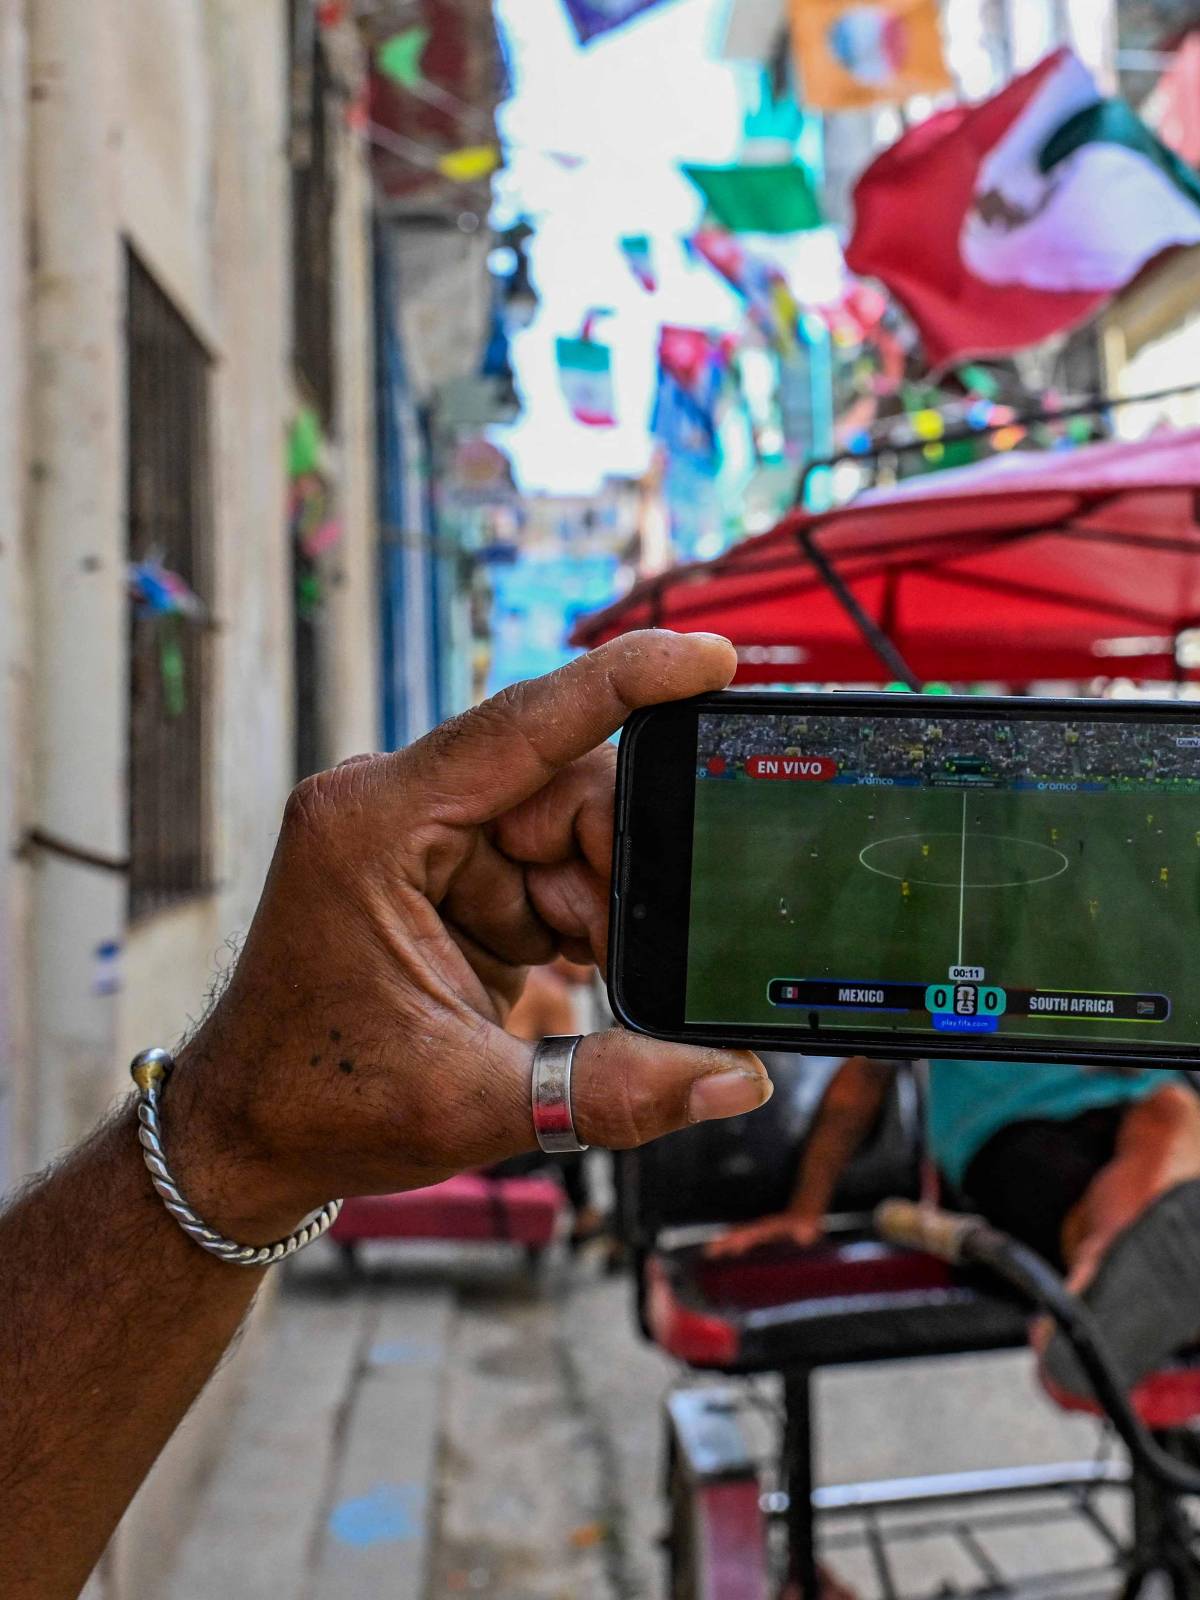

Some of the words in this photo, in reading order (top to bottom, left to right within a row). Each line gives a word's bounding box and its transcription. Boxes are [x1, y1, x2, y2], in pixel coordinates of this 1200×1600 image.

[757, 760, 778, 774] EN
[783, 761, 823, 775] VIVO
[1037, 781, 1078, 791] aramco
[953, 968, 980, 979] 00:11
[838, 988, 885, 1004] MEXICO
[933, 988, 947, 1009] 0
[984, 990, 998, 1011] 0
[1029, 996, 1069, 1012] SOUTH
[1070, 998, 1115, 1014] AFRICA
